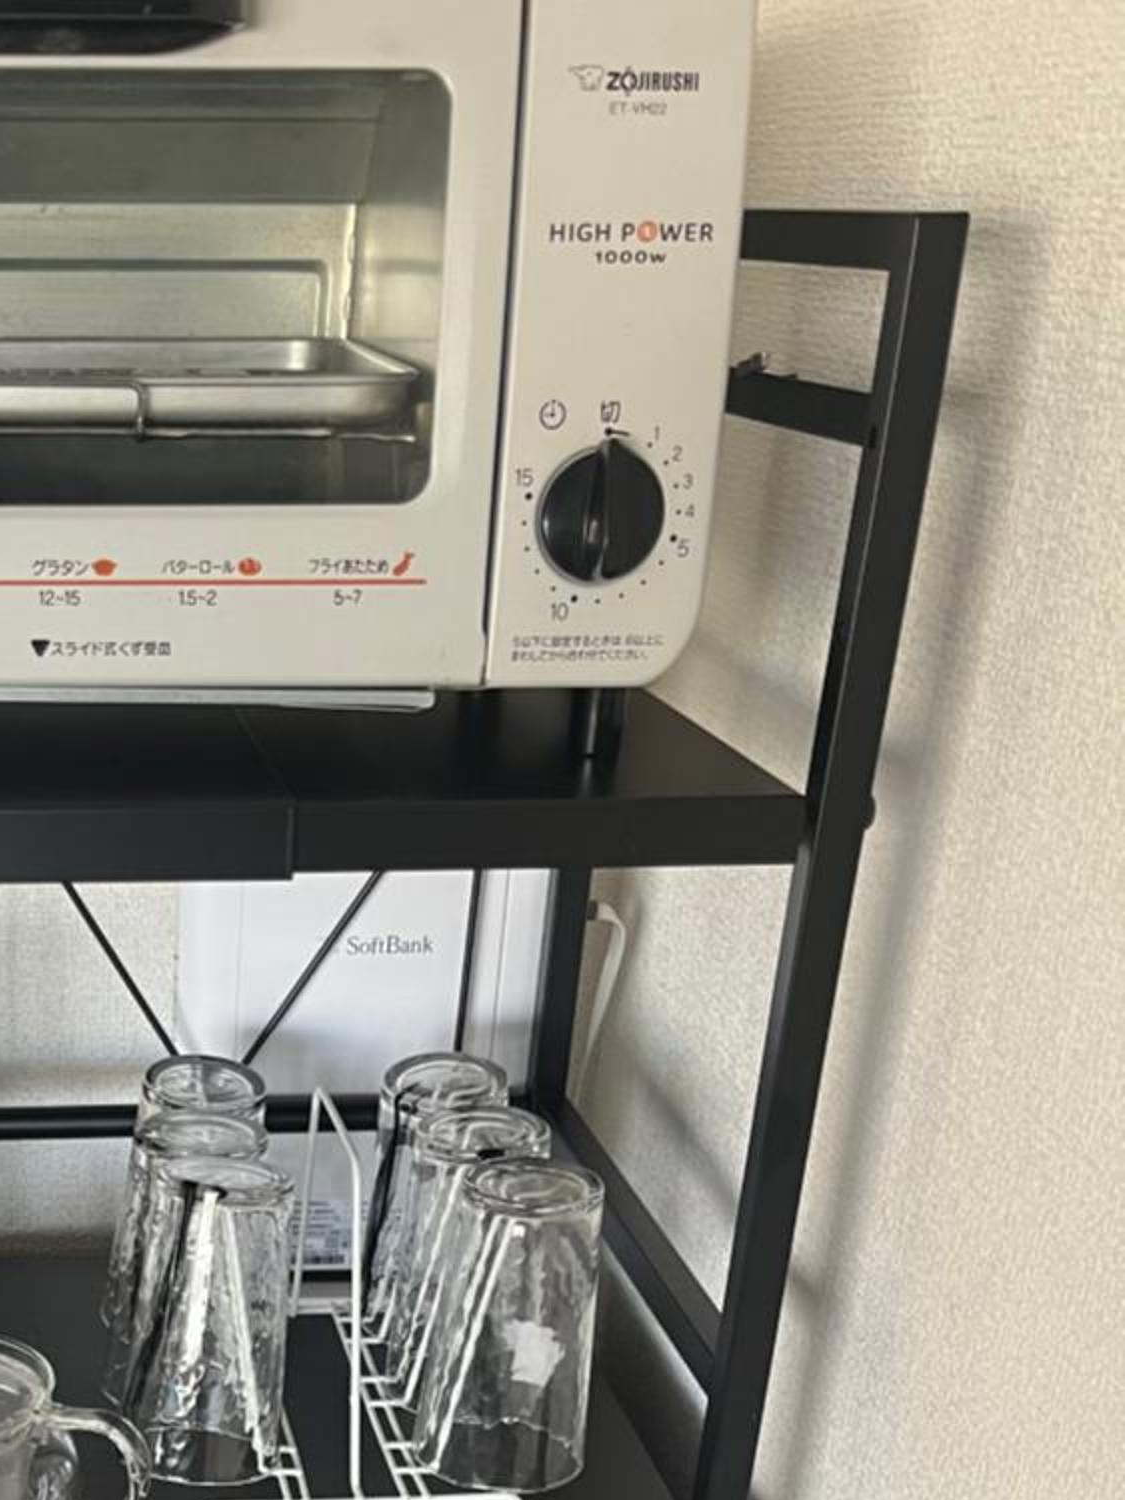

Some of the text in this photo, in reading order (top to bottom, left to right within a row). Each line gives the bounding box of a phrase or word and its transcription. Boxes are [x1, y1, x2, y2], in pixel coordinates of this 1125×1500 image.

[606, 67, 700, 96] ZOJIRUSHI
[548, 220, 715, 244] HIGH POWER
[672, 445, 683, 462] 2
[515, 467, 534, 487] 15
[682, 473, 694, 490] 3
[684, 503, 695, 519] 4
[676, 538, 690, 558] 5
[31, 559, 90, 577] グラタン
[162, 559, 235, 576] バターロール
[309, 557, 390, 575] フライあたため
[550, 602, 570, 622] 10
[346, 934, 436, 956] SoftBank
